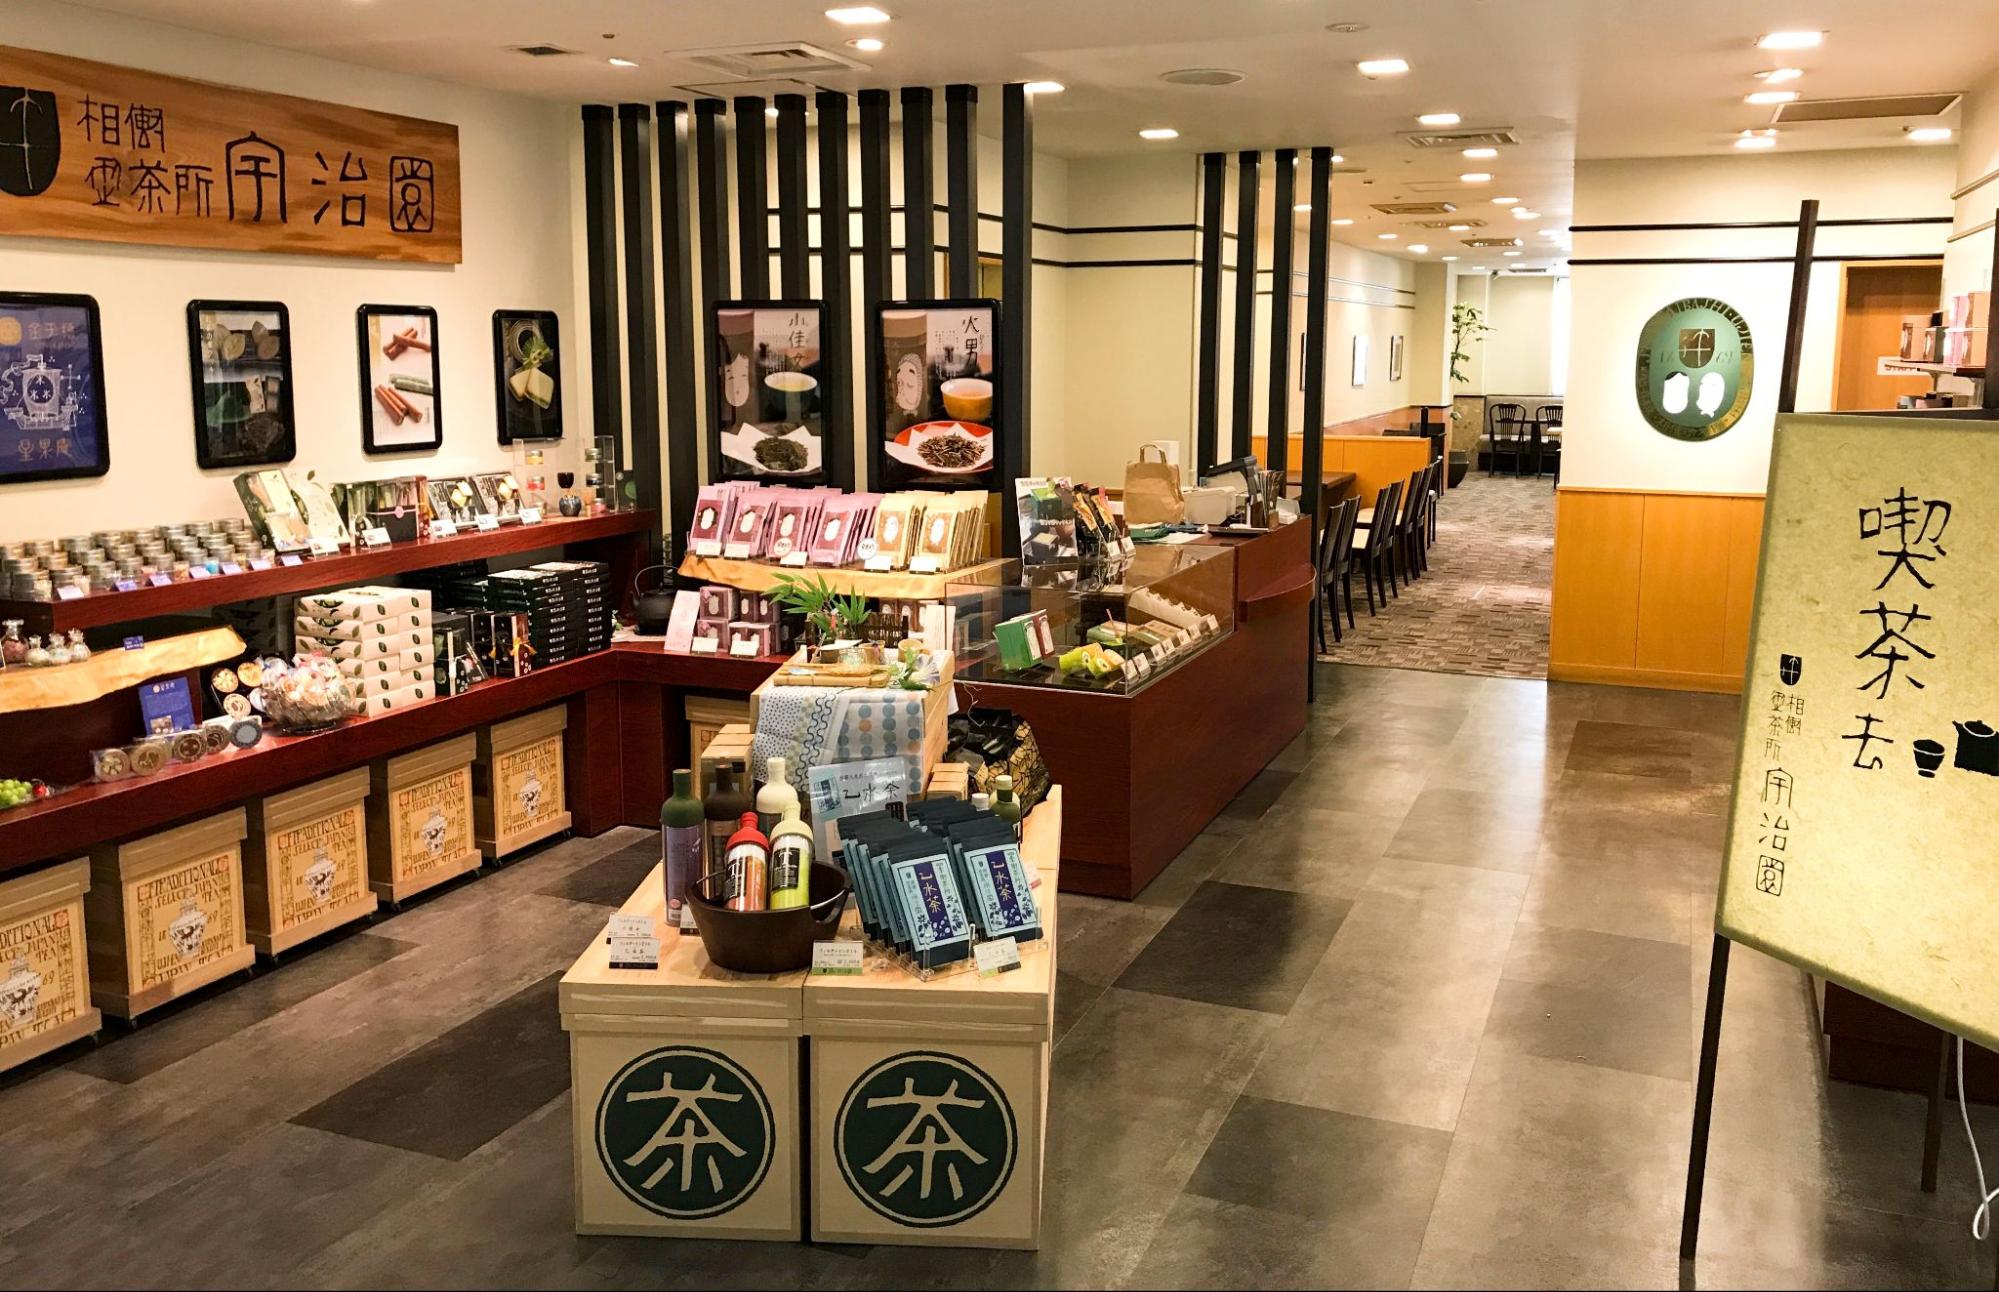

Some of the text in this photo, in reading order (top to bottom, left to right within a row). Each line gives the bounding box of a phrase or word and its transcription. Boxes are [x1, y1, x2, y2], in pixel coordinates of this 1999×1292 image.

[225, 131, 435, 233] 宇治園
[962, 315, 980, 368] 火男
[1841, 487, 1951, 769] 喫茶去
[1756, 767, 1793, 896] 宇治園
[623, 1072, 748, 1193] 茶
[862, 1077, 989, 1200] 茶
